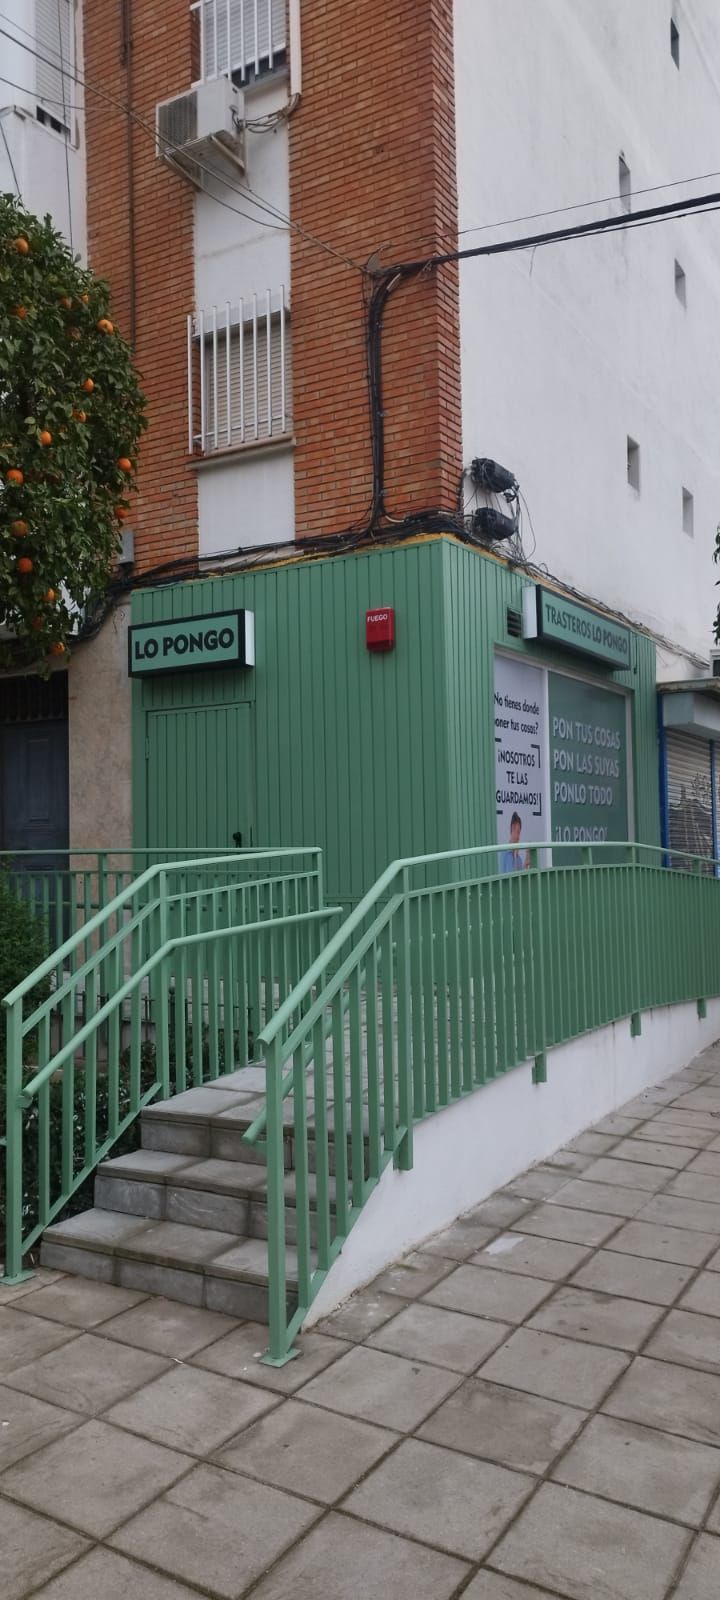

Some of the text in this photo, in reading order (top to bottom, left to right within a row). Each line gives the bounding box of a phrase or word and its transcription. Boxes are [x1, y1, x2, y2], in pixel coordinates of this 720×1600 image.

[367, 613, 388, 622] FUEGO
[545, 604, 628, 655] TRASTEROS LO PONGO
[135, 628, 235, 660] LO PONGO
[504, 694, 522, 711] tienes
[522, 699, 540, 715] donde
[494, 718, 539, 735] oner tus cosas?
[553, 716, 620, 750] PON TUS COSAS
[497, 749, 535, 767] ¡NOSOTROS
[553, 748, 619, 778] PON LAS SUYAS
[506, 770, 529, 786] TE LAS
[495, 790, 539, 806] GUARDAMOS!
[554, 781, 613, 806] PONLO TODO
